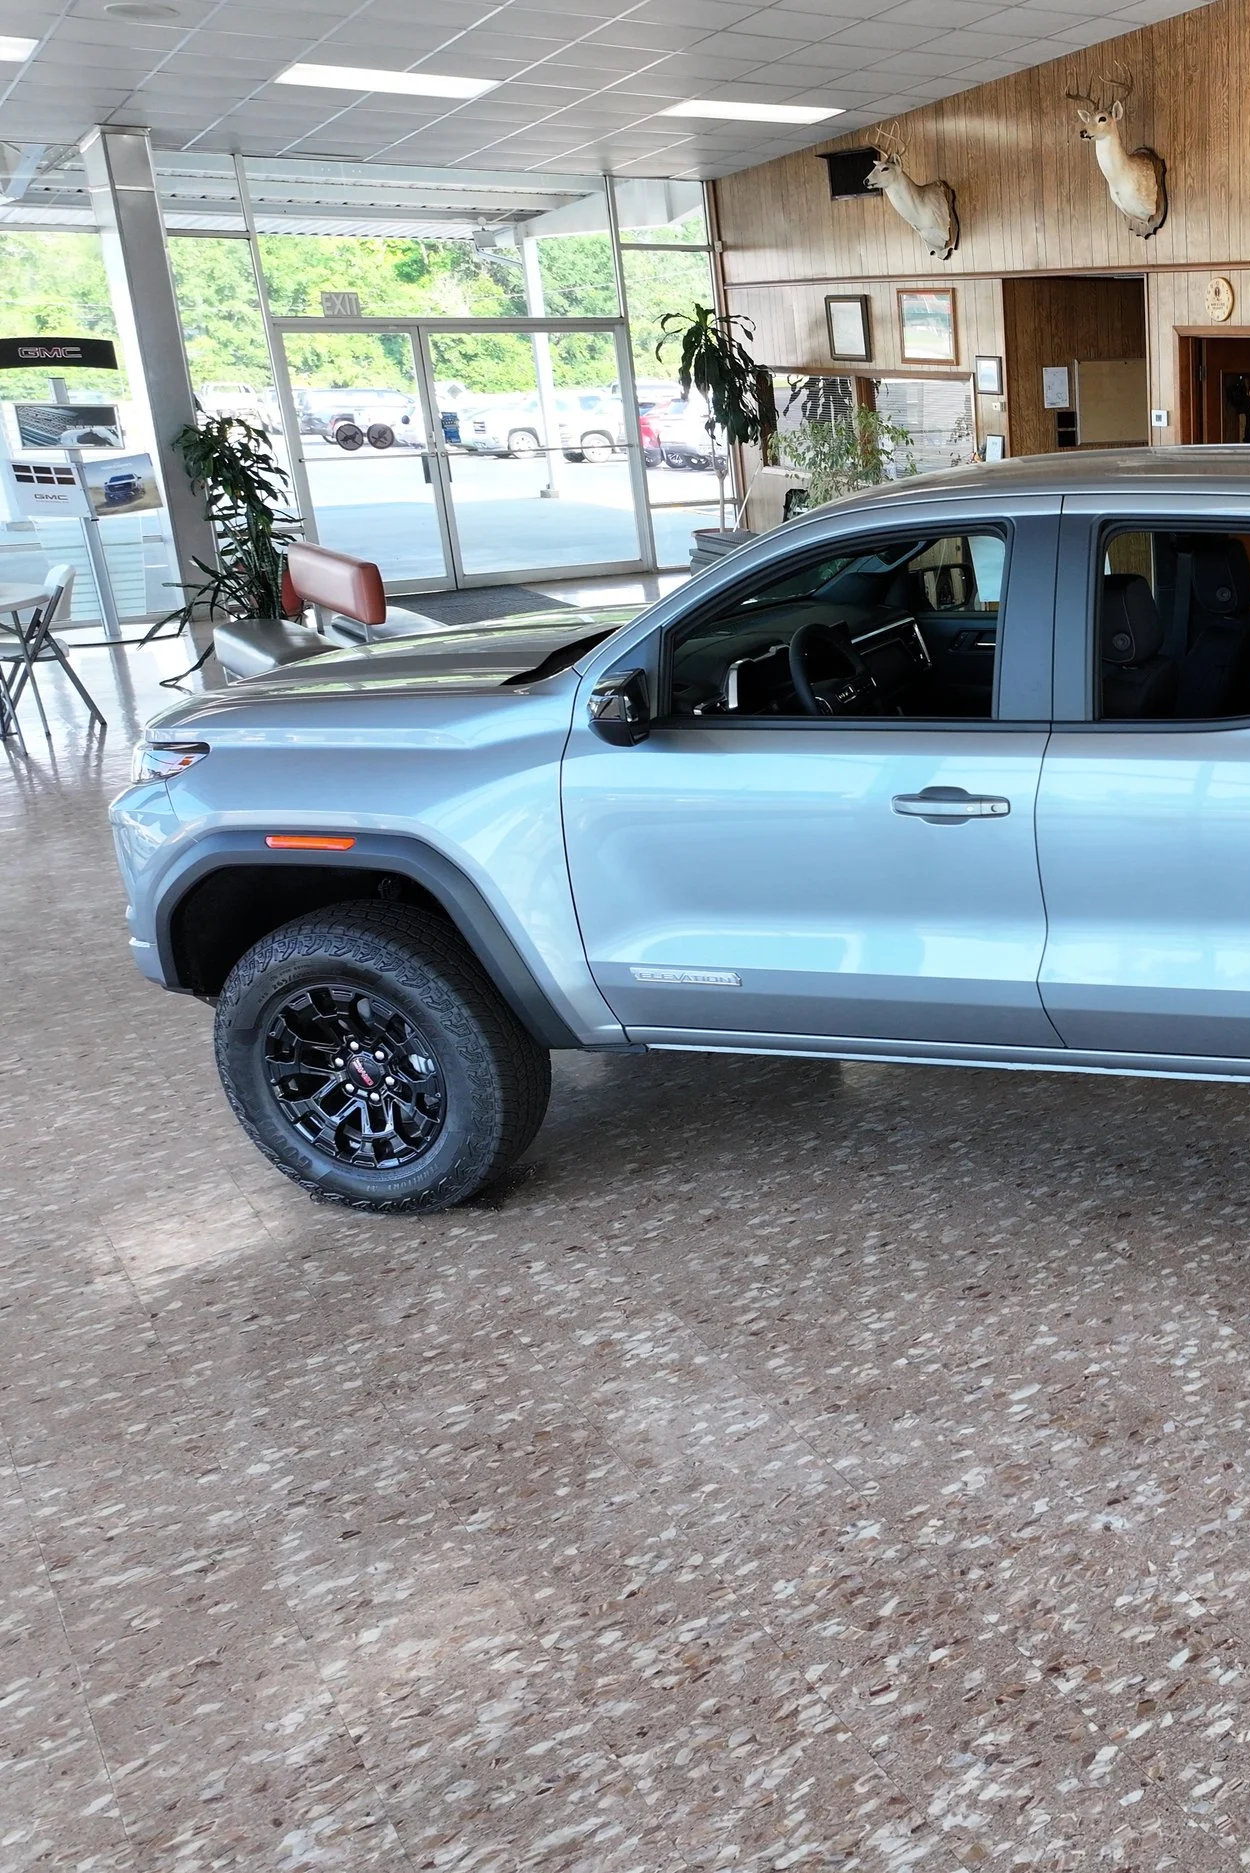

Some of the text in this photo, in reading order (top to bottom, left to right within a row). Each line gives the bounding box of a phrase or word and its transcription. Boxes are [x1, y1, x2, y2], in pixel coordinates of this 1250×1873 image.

[322, 293, 358, 315] EXIT
[18, 346, 83, 359] GMC
[34, 493, 68, 501] GMC
[638, 971, 735, 984] ELEVATION
[352, 1058, 375, 1087] GMC
